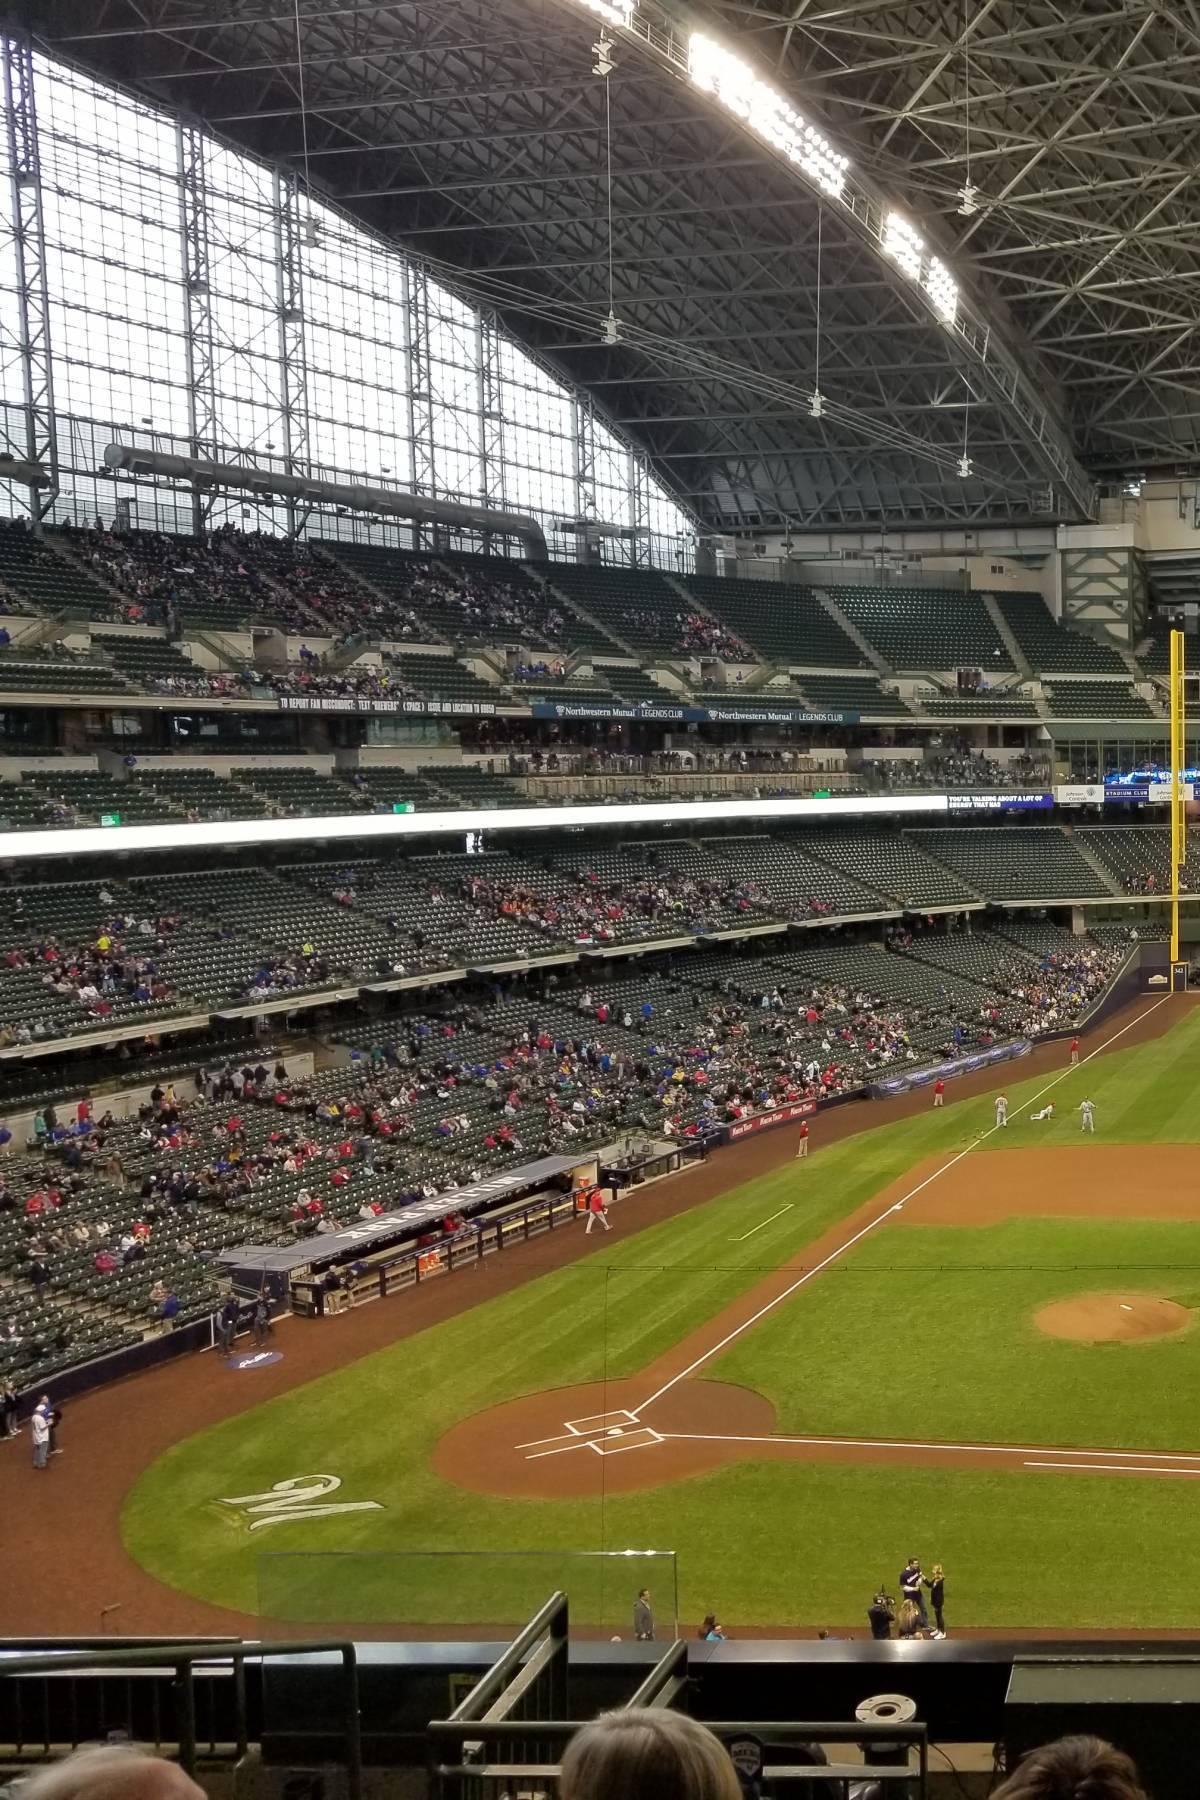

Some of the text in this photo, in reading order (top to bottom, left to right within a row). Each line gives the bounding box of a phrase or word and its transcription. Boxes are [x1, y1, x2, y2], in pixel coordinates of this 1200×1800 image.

[565, 706, 683, 718] Northwestern Mutual LEGENDS CLUB
[718, 711, 843, 722] Northwestern Mutual LEGENDS CLUB
[335, 1211, 426, 1239] PARK
